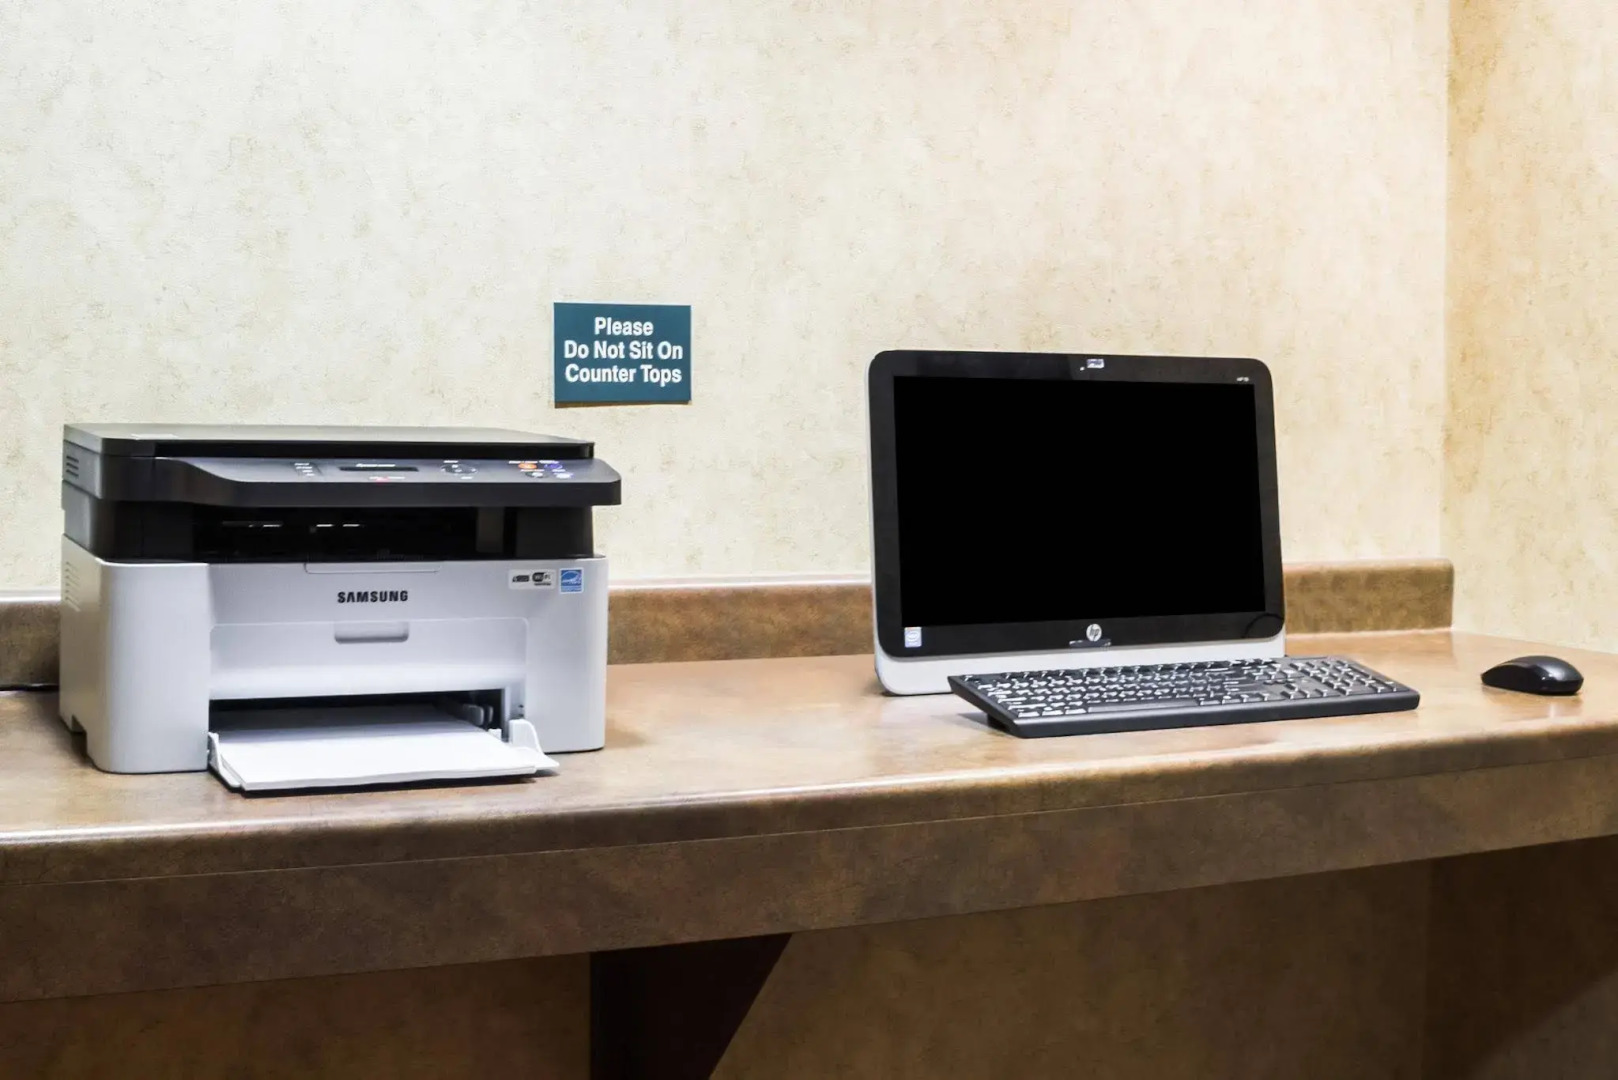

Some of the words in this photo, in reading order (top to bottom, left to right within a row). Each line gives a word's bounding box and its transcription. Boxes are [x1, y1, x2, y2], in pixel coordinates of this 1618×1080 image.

[594, 316, 654, 336] Please
[563, 339, 589, 359] Do
[593, 340, 625, 359] Not
[629, 340, 653, 360] Sit
[657, 341, 683, 360] On
[564, 363, 637, 383] Counter
[640, 364, 682, 387] Tops
[337, 590, 408, 604] SAMSUNG
